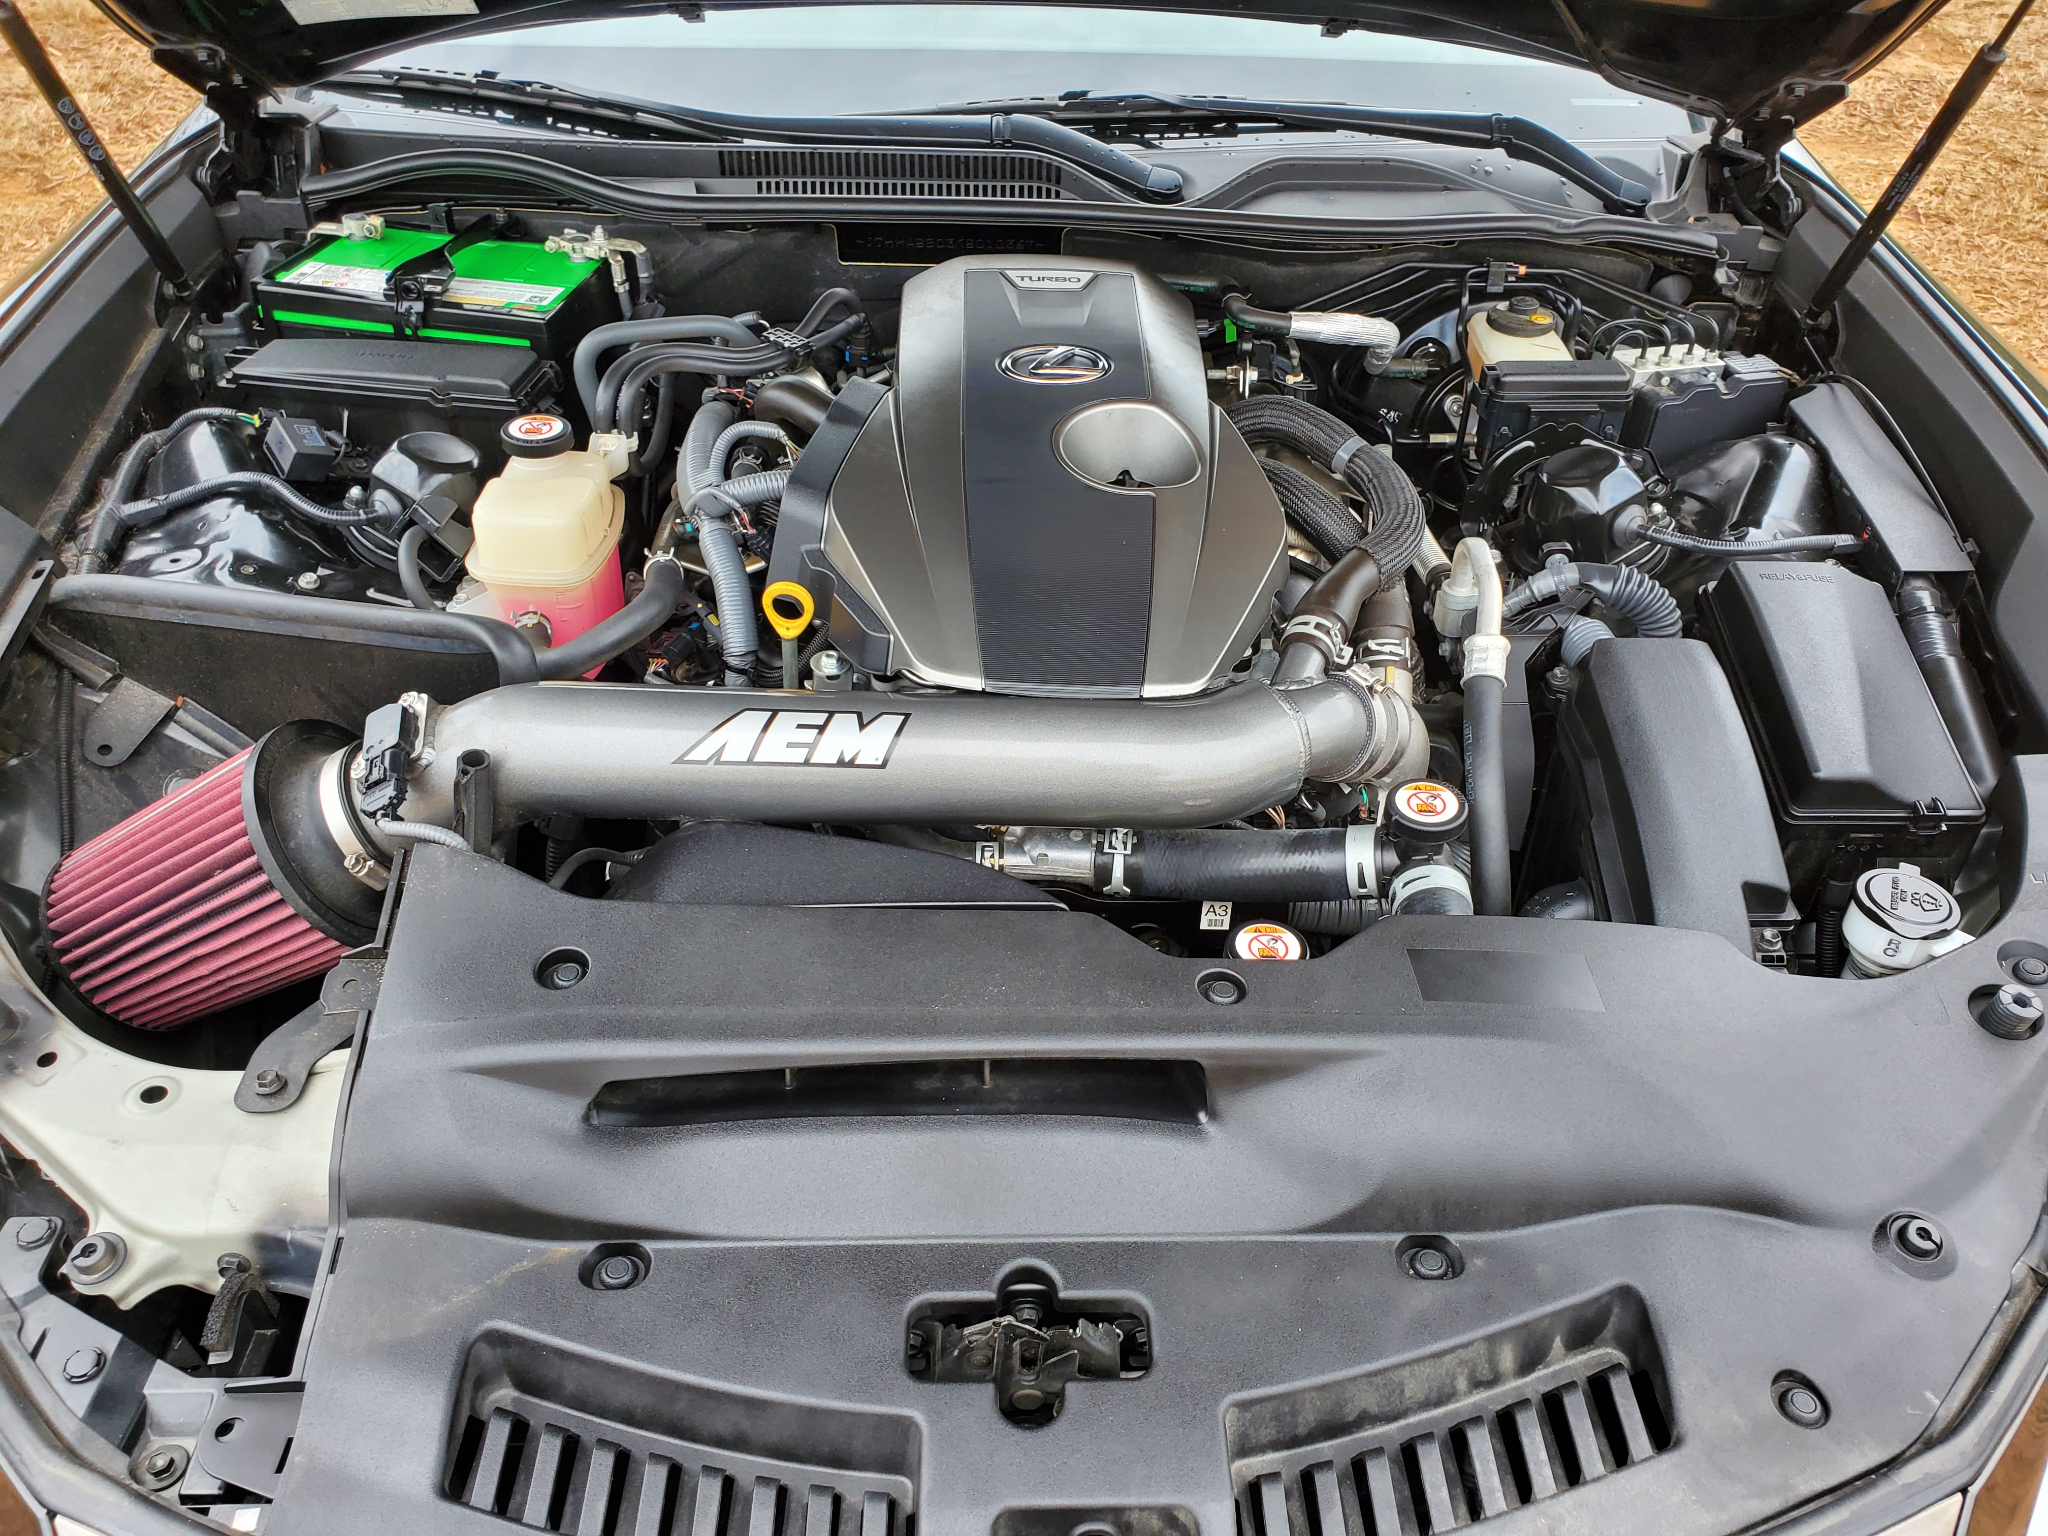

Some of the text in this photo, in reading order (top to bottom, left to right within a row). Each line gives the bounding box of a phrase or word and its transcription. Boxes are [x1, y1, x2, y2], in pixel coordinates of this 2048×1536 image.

[1015, 275, 1082, 283] TURBO
[680, 709, 907, 767] AEM
[1204, 904, 1229, 917] A3
